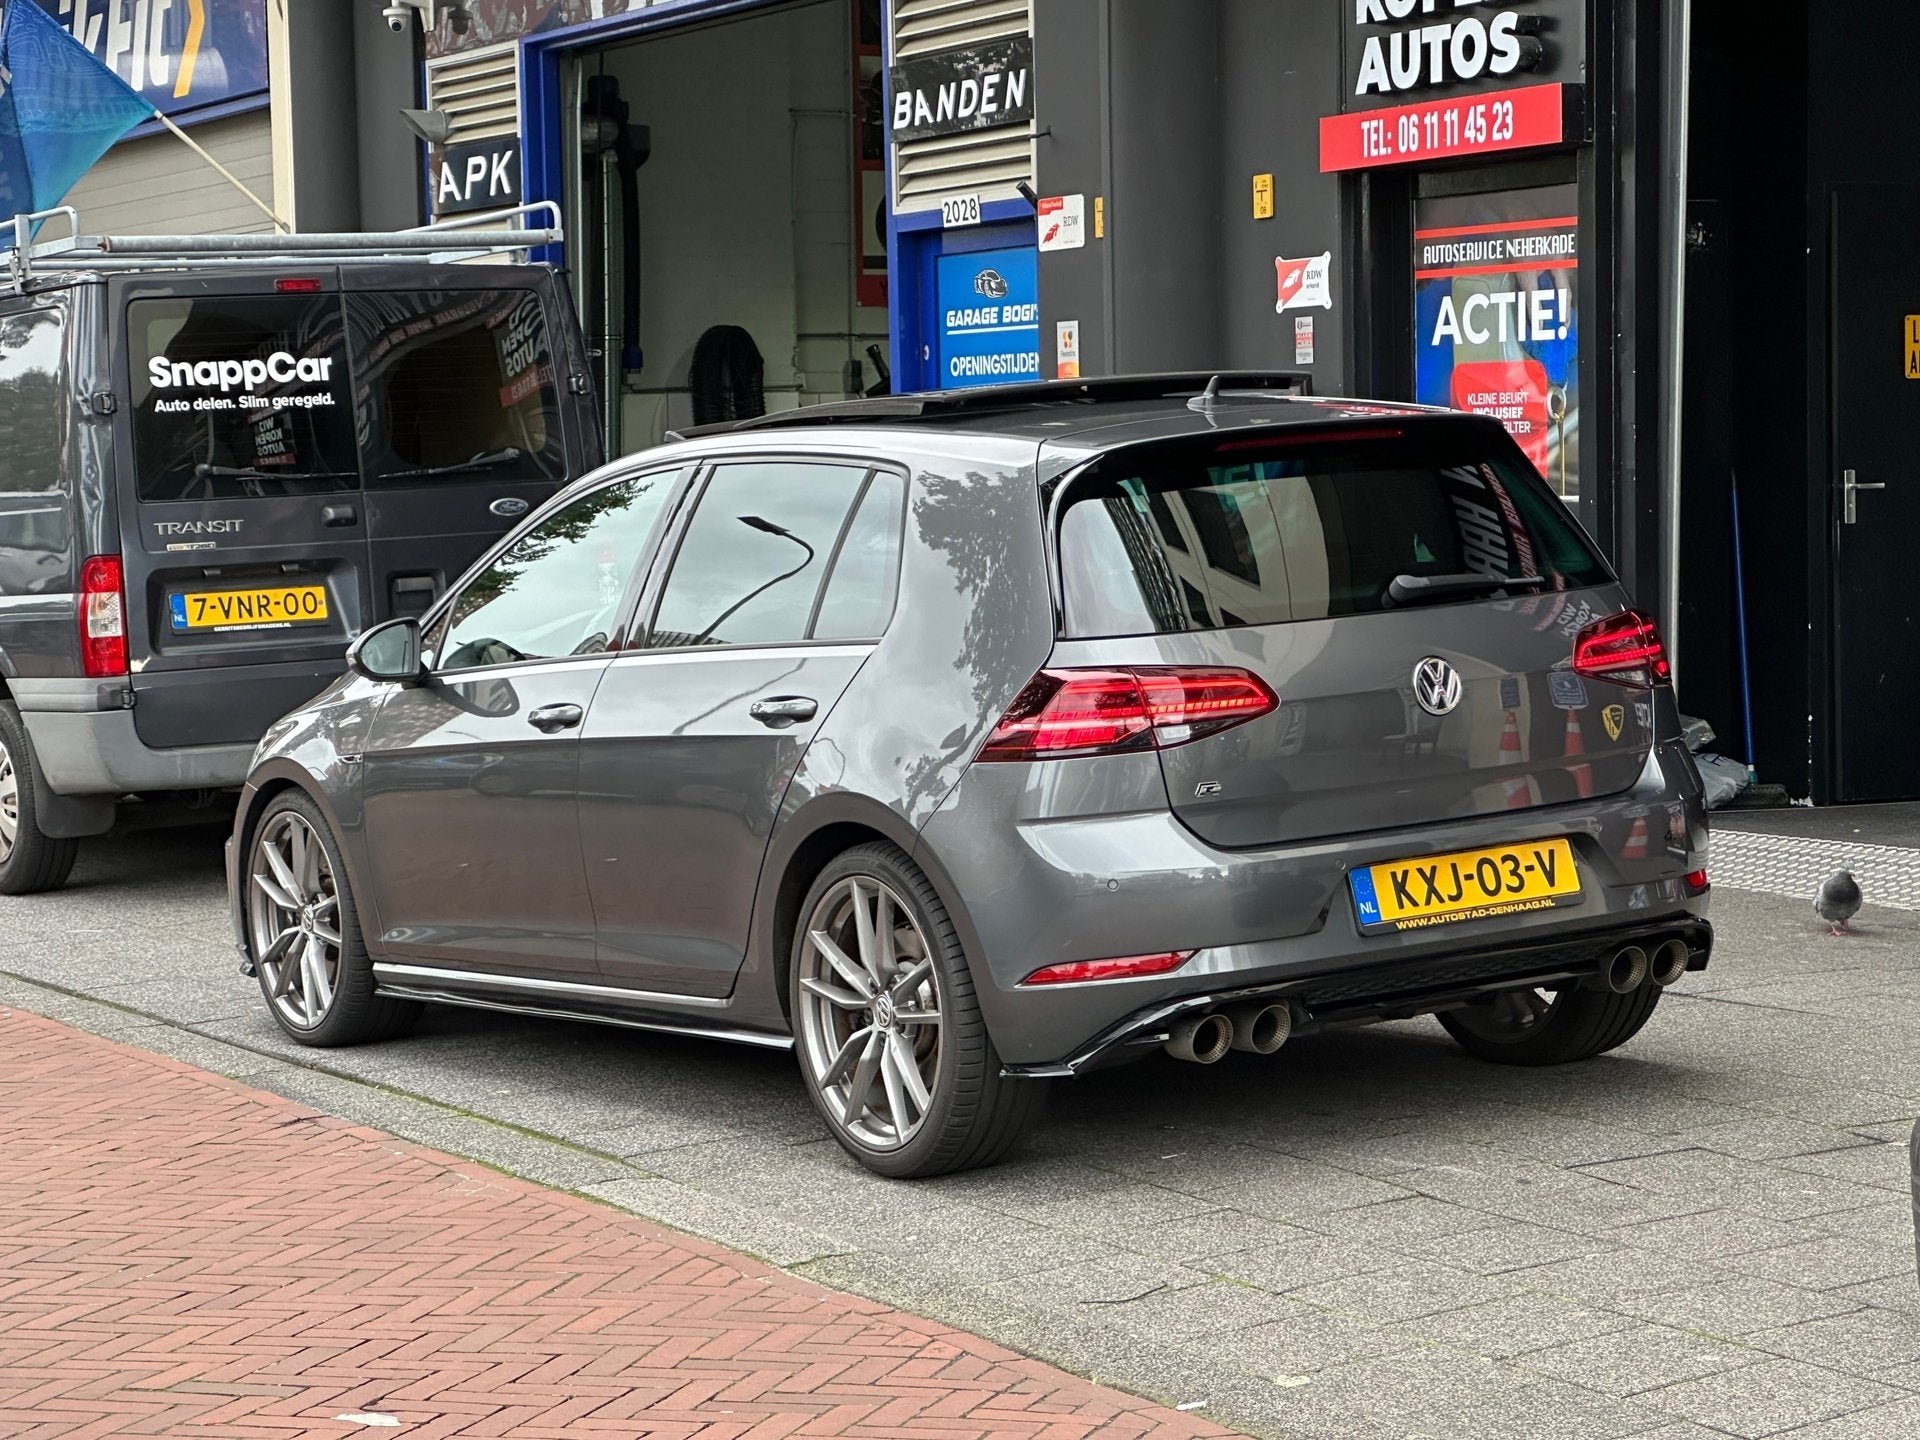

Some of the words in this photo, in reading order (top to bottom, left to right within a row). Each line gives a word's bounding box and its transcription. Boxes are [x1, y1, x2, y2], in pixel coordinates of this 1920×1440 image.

[1354, 11, 1521, 95] AUTOS
[893, 68, 1027, 130] BANDEN
[1360, 119, 1392, 158] TEL:
[1398, 113, 1419, 154] 06
[1423, 110, 1439, 149] 11
[1444, 108, 1459, 147] 11
[1464, 104, 1487, 144] 45
[1492, 100, 1514, 141] 23
[438, 150, 513, 204] APK
[944, 197, 978, 223] 2028
[1063, 214, 1079, 227] RDW
[1423, 239, 1503, 265] AUTOSERVICE
[1506, 233, 1576, 259] NEHERKADE
[1306, 269, 1323, 280] RDW
[946, 306, 999, 327] GARAGE
[1431, 288, 1568, 346] ACTIE!
[148, 351, 332, 392] SnappCar
[154, 399, 190, 413] Auto
[193, 397, 236, 411] delen.
[238, 395, 269, 408] Slim
[272, 392, 336, 410] geregeld.
[1467, 392, 1498, 406] KLEINE
[1499, 391, 1529, 405] BEURT
[153, 519, 244, 536] TRANSIT
[174, 614, 186, 623] NL
[193, 591, 318, 622] 7-VNR-00
[1389, 848, 1555, 910] KXJ-03-V
[1360, 902, 1377, 915] NL
[1395, 899, 1556, 930] WWW.AUTOSTAD-DENHAAG.NL
